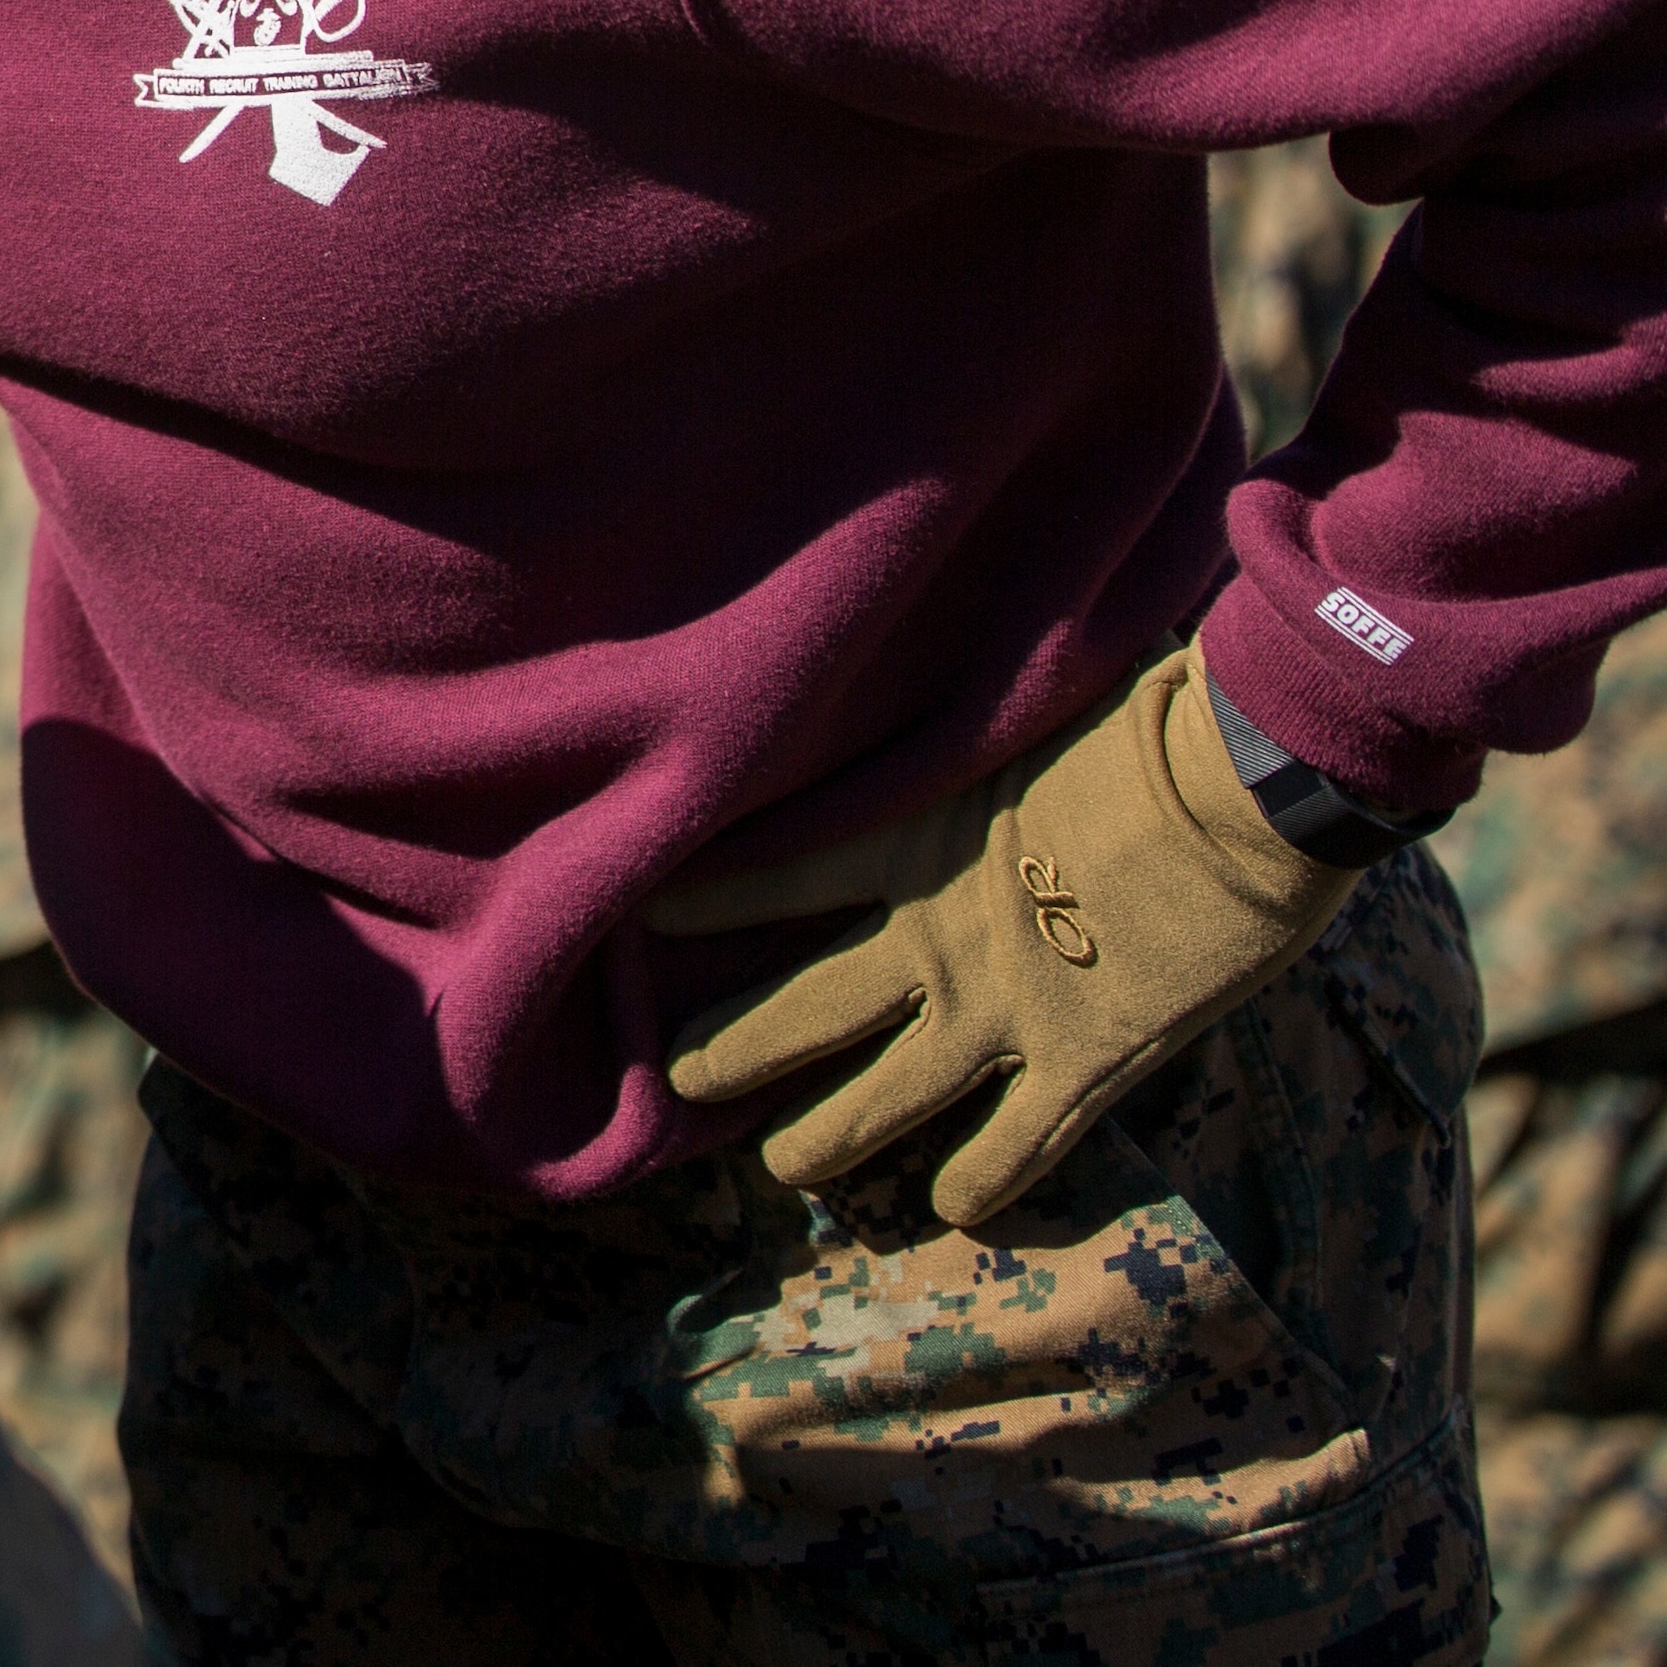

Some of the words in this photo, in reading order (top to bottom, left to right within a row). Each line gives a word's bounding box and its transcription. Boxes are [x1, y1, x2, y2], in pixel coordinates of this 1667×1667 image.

[159, 77, 205, 95] FOURTH
[209, 77, 259, 94] RECRUIT
[262, 74, 318, 92] TRAINING
[322, 67, 402, 88] BATTALION
[1321, 591, 1408, 660] SOFFE
